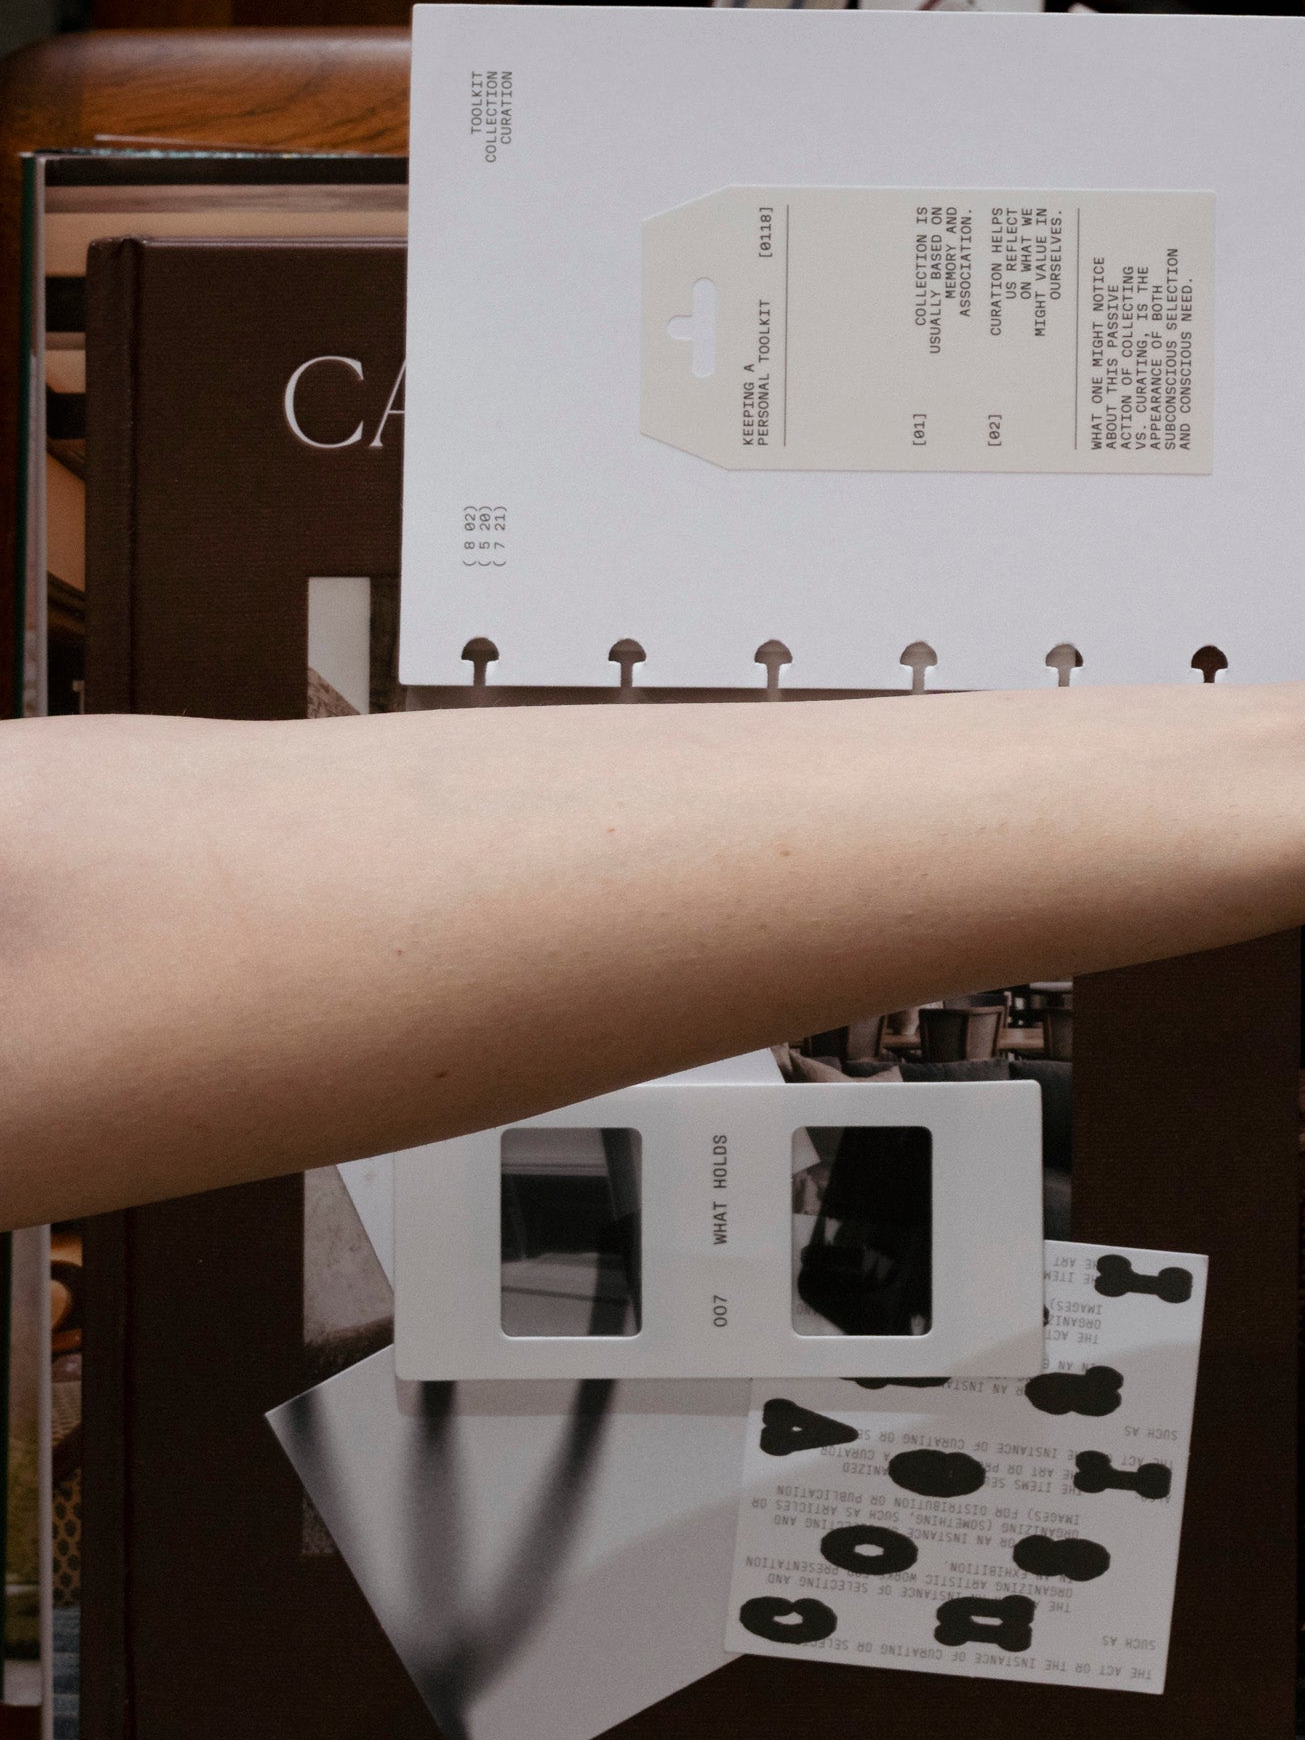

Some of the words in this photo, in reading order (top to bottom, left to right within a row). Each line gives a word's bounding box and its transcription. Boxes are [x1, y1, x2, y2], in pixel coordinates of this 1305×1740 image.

[471, 71, 483, 134] TOOLKIT
[501, 72, 512, 144] CURATION
[485, 71, 497, 162] COLLECTION
[917, 207, 927, 224] IS
[931, 208, 942, 225] ON
[946, 207, 957, 234] AND
[1022, 209, 1032, 226] WE
[1036, 209, 1047, 225] IN
[759, 208, 773, 257] [0118]
[992, 208, 1003, 252] HELPS
[1006, 208, 1017, 271] REFLECT
[931, 235, 942, 279] BASED
[960, 210, 971, 317] ASSOCIATION.
[1021, 236, 1031, 272] WHAT
[1036, 236, 1046, 281] VALUE
[1050, 211, 1062, 300] OURSELVES.
[915, 235, 927, 325] COLLECTION
[945, 245, 956, 298] MEMORY
[1137, 267, 1148, 293] THE
[1006, 282, 1016, 299] US
[1020, 282, 1031, 299] ON
[1093, 258, 1104, 311] NOTICE
[1166, 249, 1178, 330] SELECTION
[990, 263, 1002, 335] CURATION
[1152, 286, 1162, 320] BOTH
[1181, 279, 1192, 321] NEED.
[929, 290, 941, 353] USUALLY
[1035, 291, 1046, 336] MIGHT
[1107, 286, 1118, 347] PASSIVE
[1122, 267, 1133, 357] COLLECTING
[1137, 304, 1148, 320] IS
[759, 300, 770, 363] TOOLKIT
[1151, 331, 1162, 349] OF
[1092, 322, 1103, 366] MIGHT
[744, 364, 754, 372] A
[1107, 359, 1118, 394] THIS
[1122, 368, 1132, 385] OF
[1136, 334, 1150, 413] CURATING,
[1180, 332, 1192, 413] CONSCIOUS
[1092, 377, 1102, 403] ONE
[1165, 341, 1177, 449] SUBCONSCIOUS
[743, 383, 754, 445] KEEPING
[758, 374, 769, 445] PERSONAL
[1150, 360, 1162, 450] APPEARANCE
[913, 414, 926, 445] [01]
[988, 415, 1002, 446] [02]
[1091, 414, 1102, 450] WHAT
[1106, 405, 1117, 449] ABOUT
[1121, 396, 1132, 449] ACTION
[1135, 426, 1146, 450] VS.
[1180, 424, 1190, 450] AND
[713, 1135, 727, 1188] HOLDS
[713, 1202, 727, 1245] WHAT
[1046, 1330, 1068, 1341] ACT
[1077, 1332, 1099, 1344] THE
[879, 1431, 895, 1444] OR
[903, 1434, 965, 1450] CURATING
[1125, 1427, 1140, 1437] AS
[1148, 1428, 1177, 1440] SUCH
[973, 1440, 989, 1452] OF
[996, 1442, 1057, 1458] INSTANCE
[1121, 1454, 1143, 1466] ACT
[751, 1497, 767, 1511] OR
[775, 1485, 862, 1507] PUBLICATION
[870, 1495, 885, 1506] OR
[776, 1500, 838, 1520] ARTICLES
[845, 1509, 860, 1522] AS
[894, 1495, 986, 1518] DISTRIBUTION
[995, 1507, 1018, 1519] FOR
[774, 1514, 797, 1527] AND
[868, 1511, 900, 1524] SUCH
[908, 1512, 993, 1532] (SOMETHING,
[1027, 1508, 1079, 1527] IMAGES)
[908, 1528, 969, 1545] INSTANCE
[1001, 1521, 1079, 1539] ORGANIZING
[976, 1535, 992, 1547] AN
[767, 1573, 790, 1587] AND
[798, 1576, 868, 1594] SELECTING
[924, 1573, 987, 1591] ARTISTIC
[995, 1580, 1073, 1598] ORGANIZING
[875, 1585, 892, 1597] OF
[1048, 1601, 1070, 1613] THE
[857, 1642, 873, 1652] OR
[881, 1641, 944, 1660] CURATING
[1103, 1636, 1117, 1646] AS
[1125, 1638, 1155, 1650] SUCH
[951, 1651, 966, 1662] OF
[975, 1650, 1035, 1669] INSTANCE
[1045, 1659, 1066, 1672] THE
[1075, 1663, 1091, 1673] OR
[1099, 1665, 1122, 1676] ACT
[1130, 1667, 1152, 1680] THE
